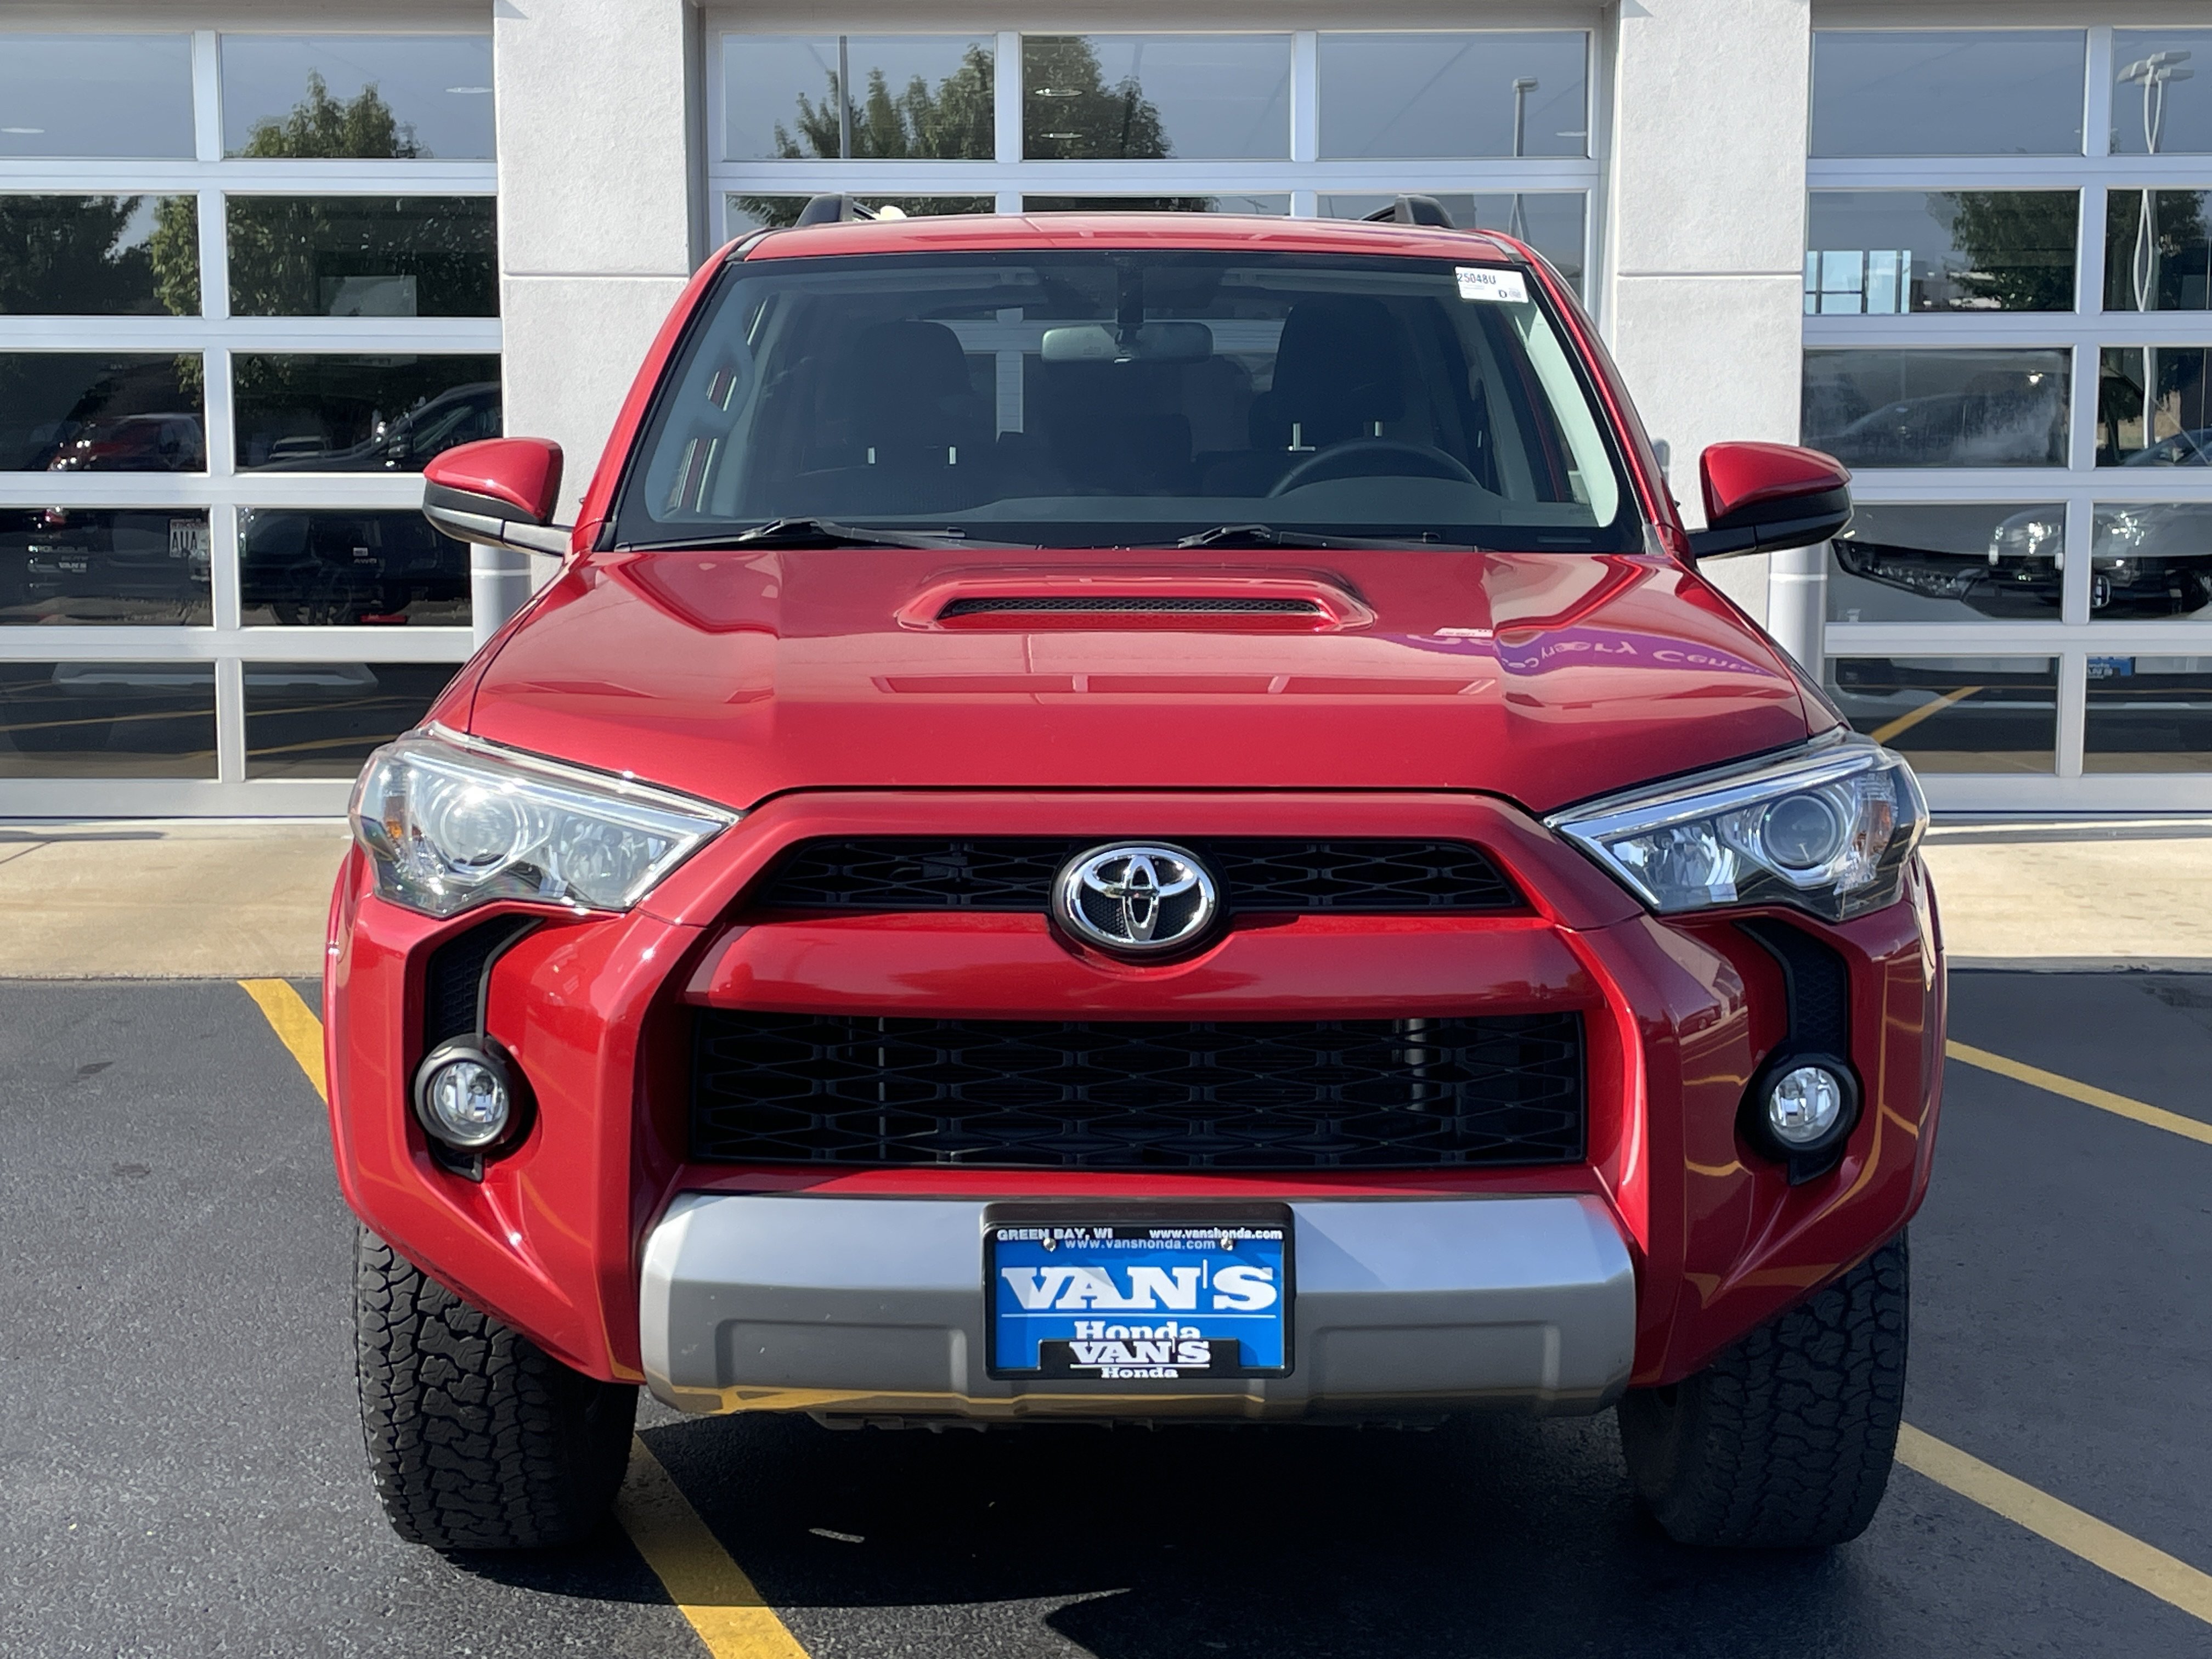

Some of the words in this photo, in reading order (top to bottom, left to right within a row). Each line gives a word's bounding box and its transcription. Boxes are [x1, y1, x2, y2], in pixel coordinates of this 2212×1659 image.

[1457, 273, 1497, 285] 25048U
[997, 1228, 1049, 1240] GREEN
[1053, 1228, 1090, 1240] BAY,
[1093, 1228, 1114, 1239] WI
[1149, 1227, 1283, 1239] www.vanshonda.com
[1001, 1259, 1278, 1311] VAN'S
[1074, 1321, 1201, 1339] Honda
[1069, 1336, 1211, 1363] VAN'S
[1101, 1367, 1178, 1378] Honda
